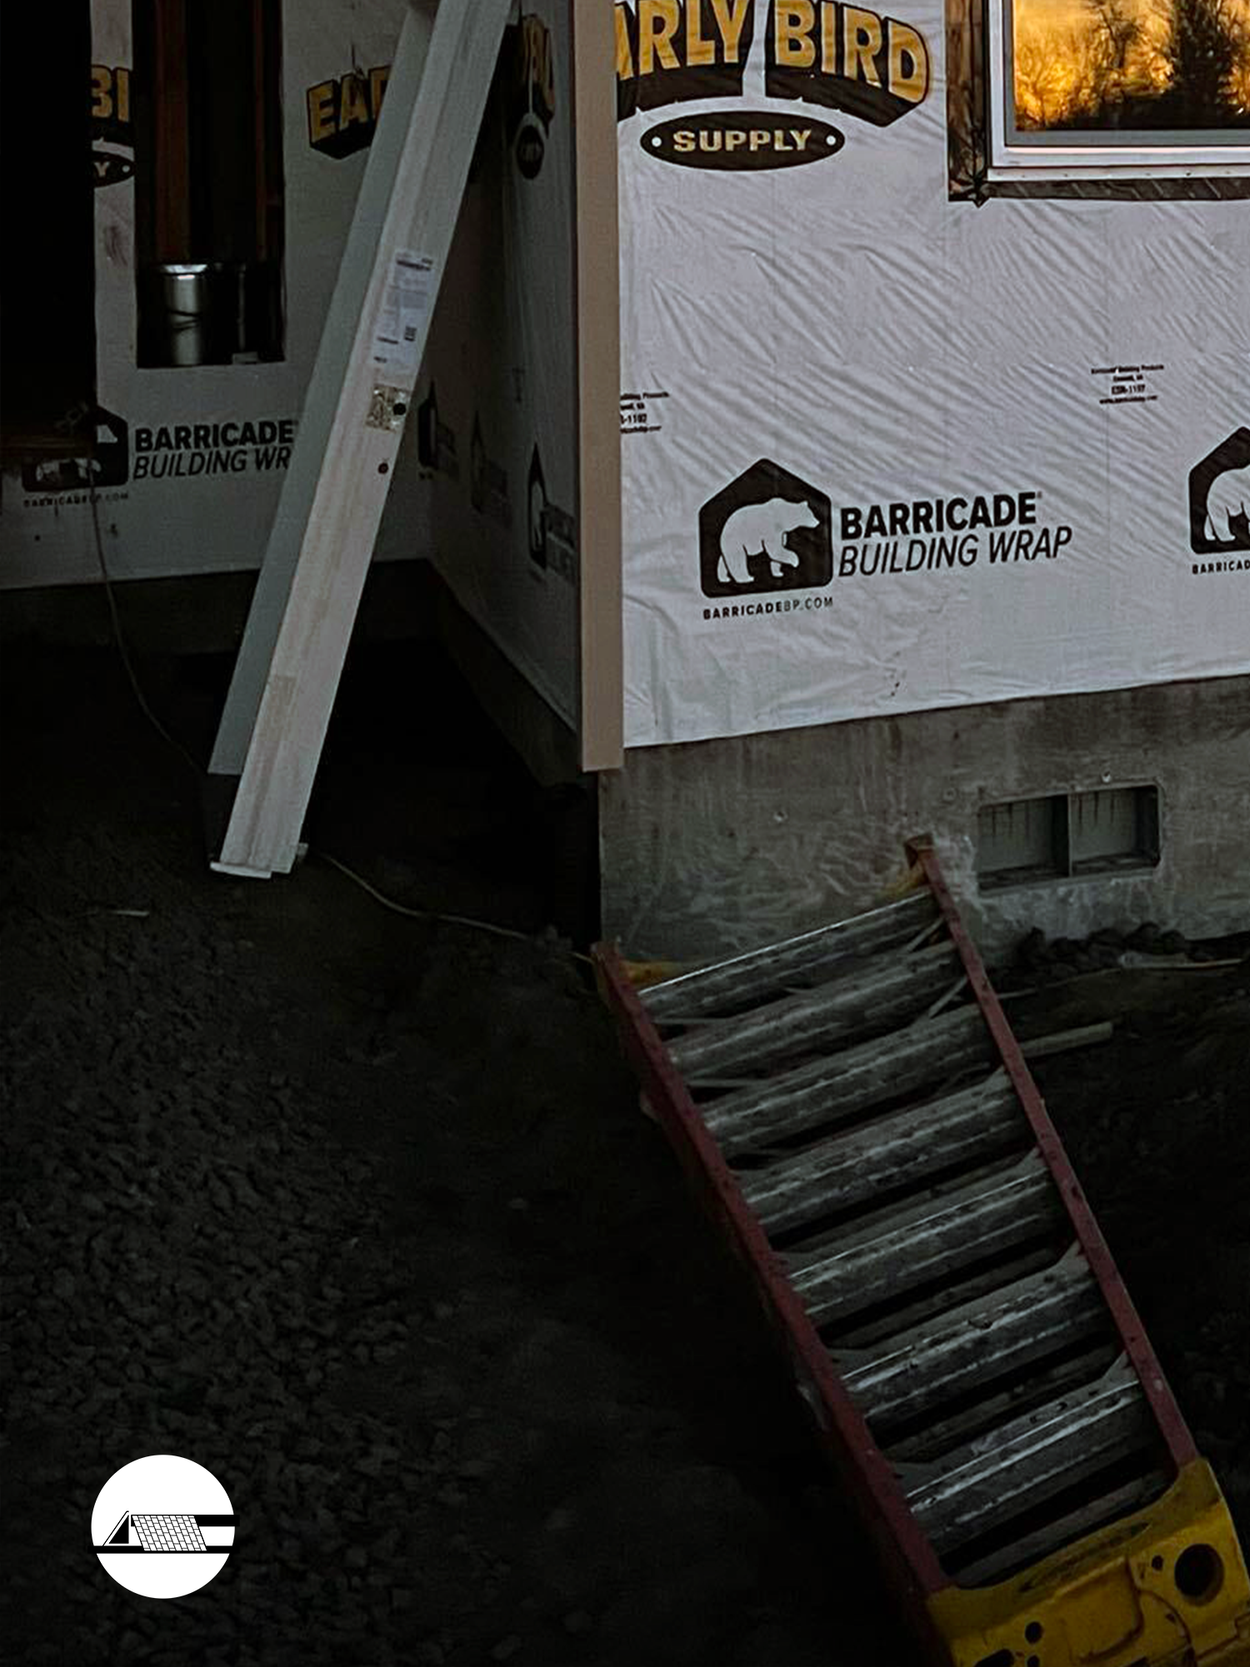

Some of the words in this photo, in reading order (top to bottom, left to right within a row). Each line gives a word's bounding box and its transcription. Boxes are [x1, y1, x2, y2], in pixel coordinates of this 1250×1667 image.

[673, 129, 812, 153] SUPPLY
[135, 420, 293, 452] BARRICADE
[133, 451, 247, 480] BUILDING
[840, 491, 1038, 541] BARRICADE
[838, 533, 978, 577] BUILDING
[988, 525, 1073, 562] WRAP
[702, 596, 834, 620] BARRICADEBP.COM
